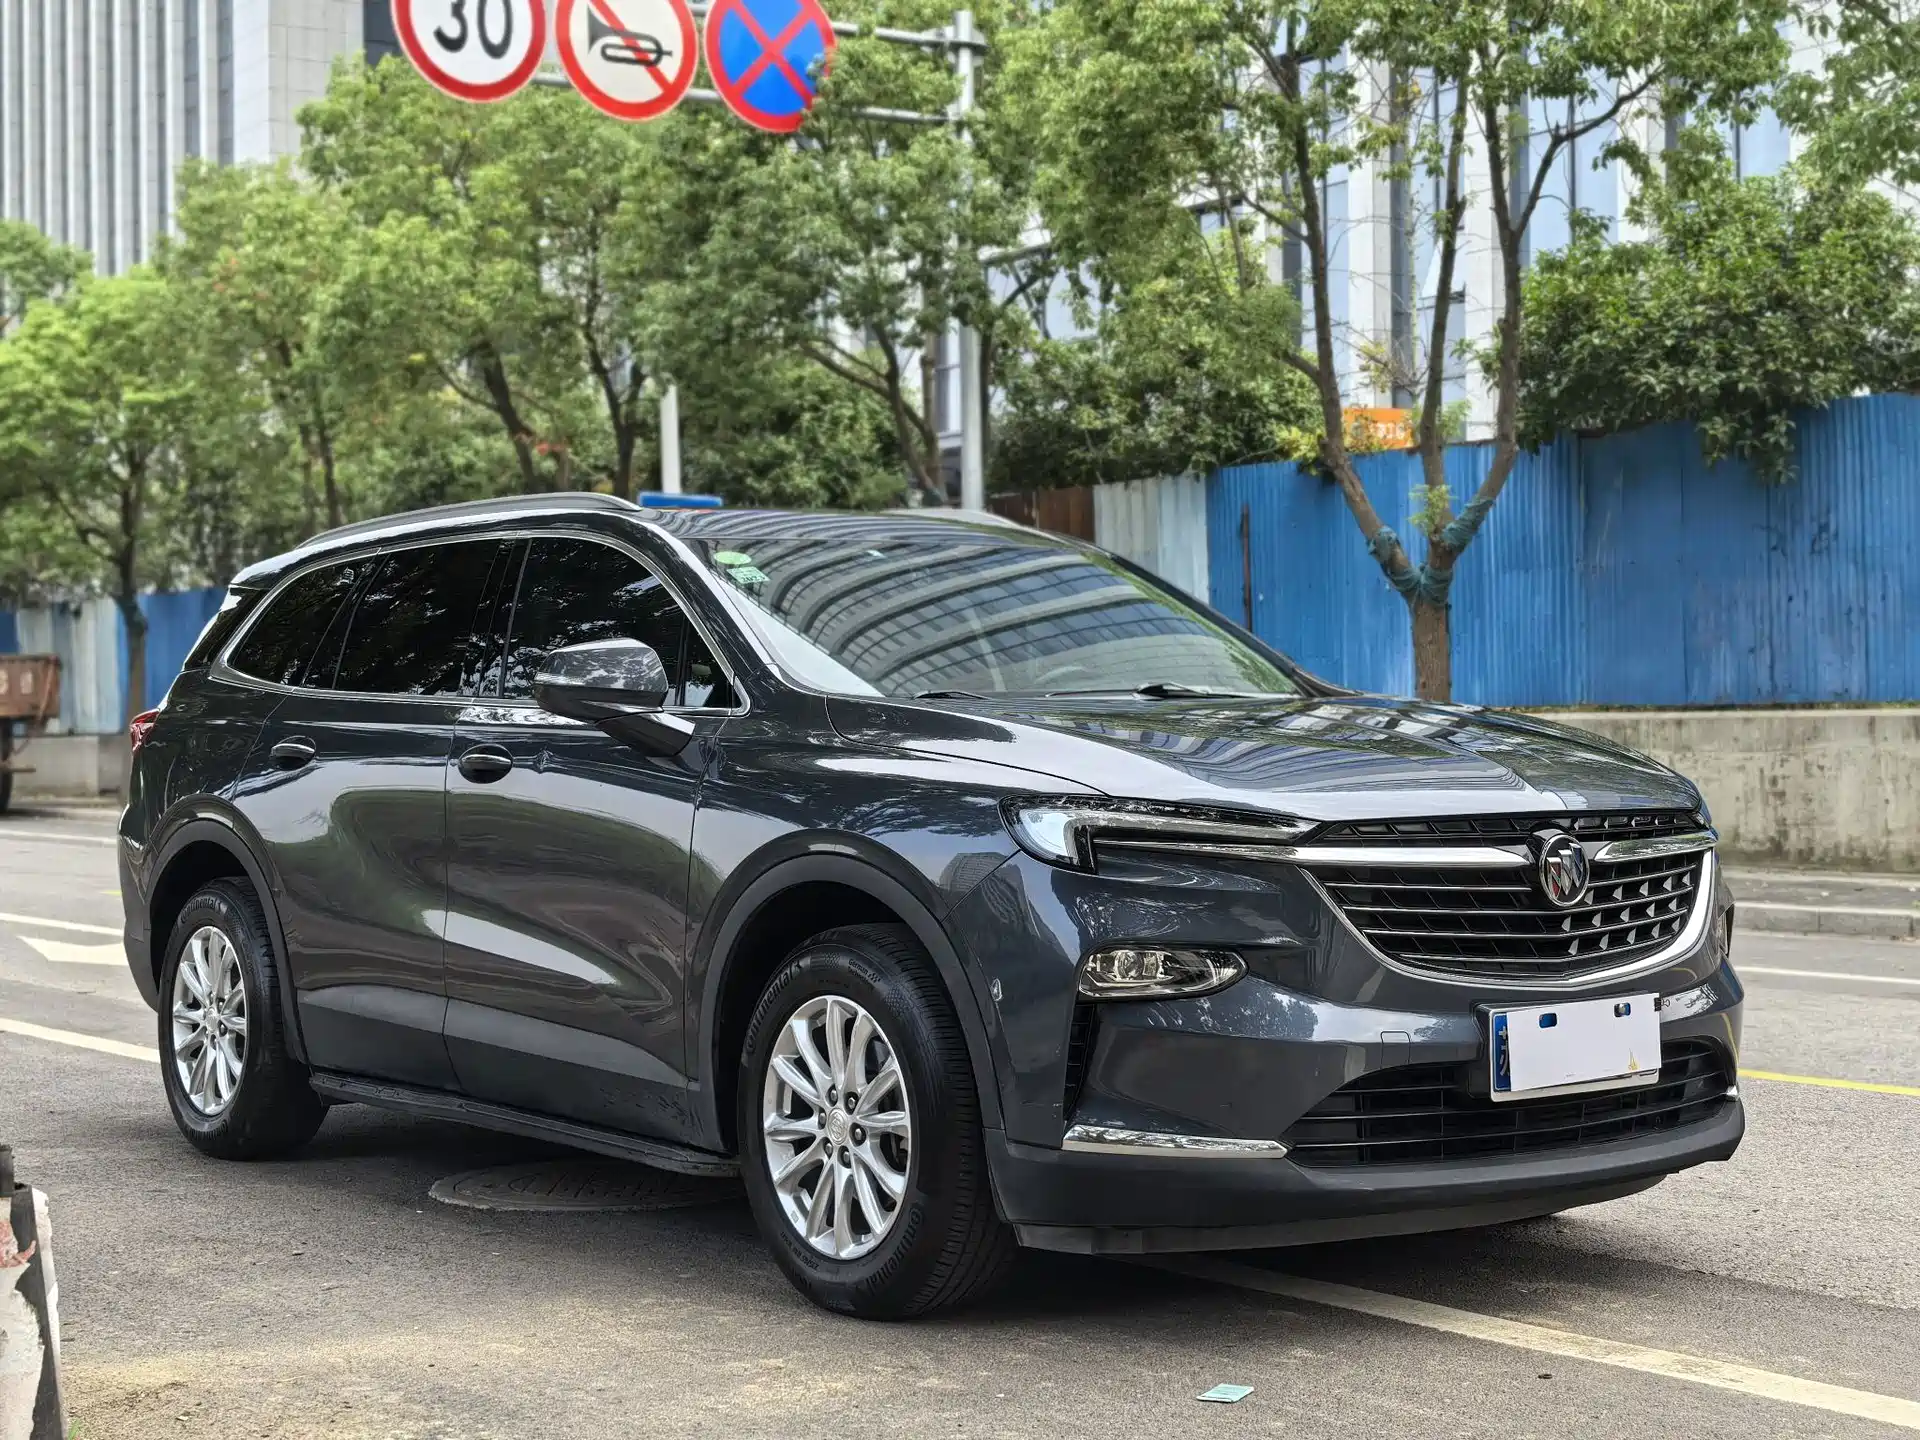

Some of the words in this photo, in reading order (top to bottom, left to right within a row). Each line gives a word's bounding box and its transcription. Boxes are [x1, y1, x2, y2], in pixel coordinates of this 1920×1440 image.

[433, 0, 512, 59] 30
[746, 963, 796, 1053] Continental
[865, 1207, 923, 1297] Continental
